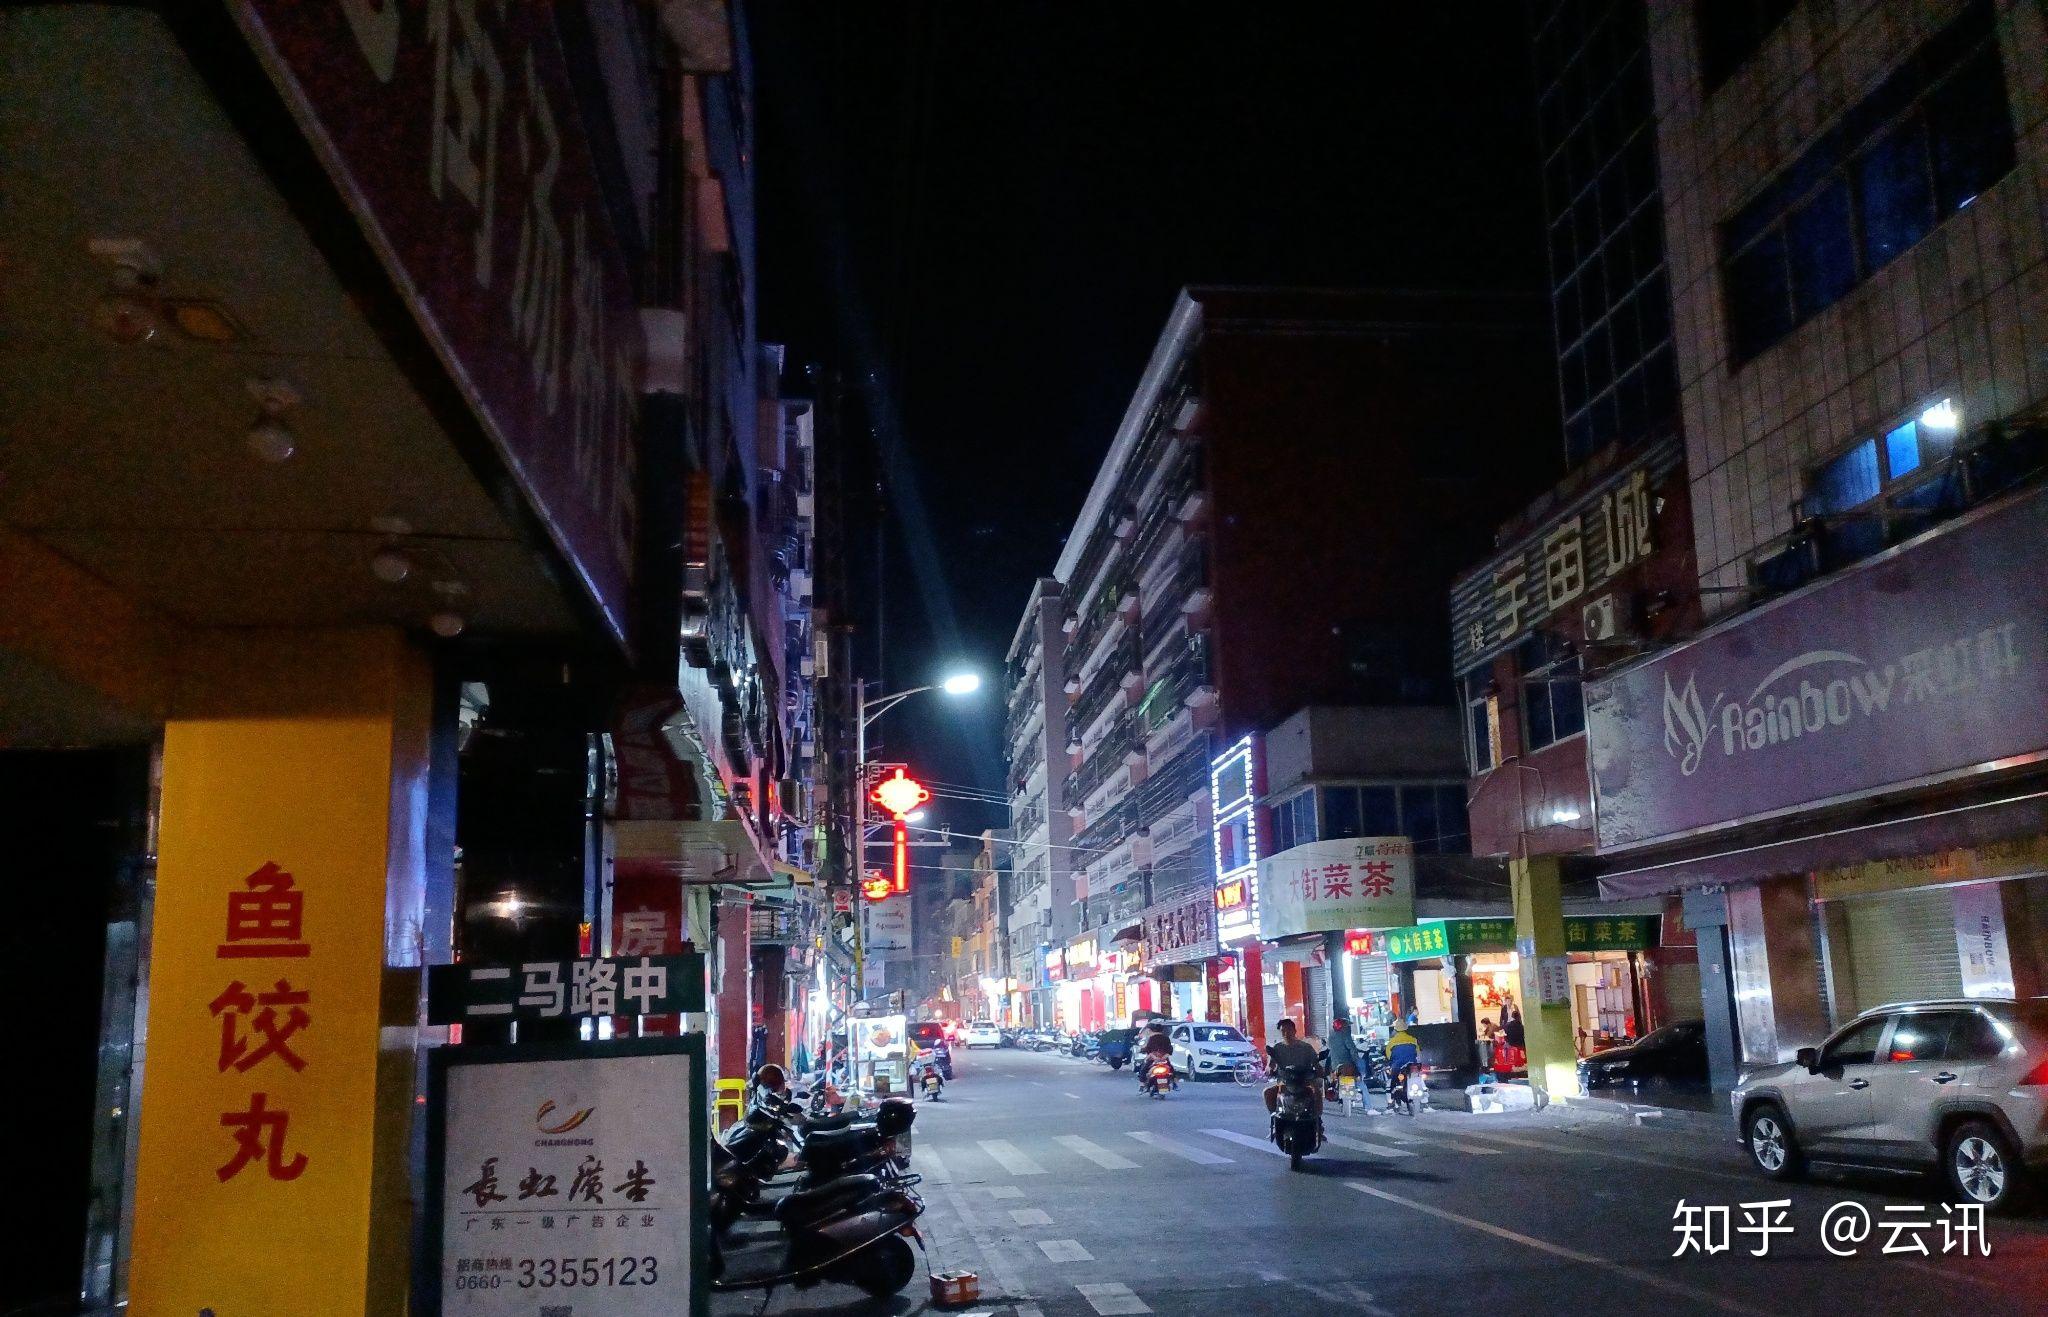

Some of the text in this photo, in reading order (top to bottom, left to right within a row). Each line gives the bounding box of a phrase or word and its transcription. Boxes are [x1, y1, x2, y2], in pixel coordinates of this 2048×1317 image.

[1493, 469, 1651, 640] 宇宙城
[1722, 665, 1897, 756] Rainbow
[1289, 861, 1395, 903] 大街菜茶
[1403, 928, 1444, 954] 大街菜茶
[466, 957, 668, 1016] 二马路中
[209, 860, 311, 1183] 鱼饺丸
[535, 1138, 594, 1147] CHANGHONG
[465, 1213, 655, 1231] 广东一级广告企业
[456, 1257, 512, 1273] 招商热线
[517, 1256, 658, 1289] 3355123
